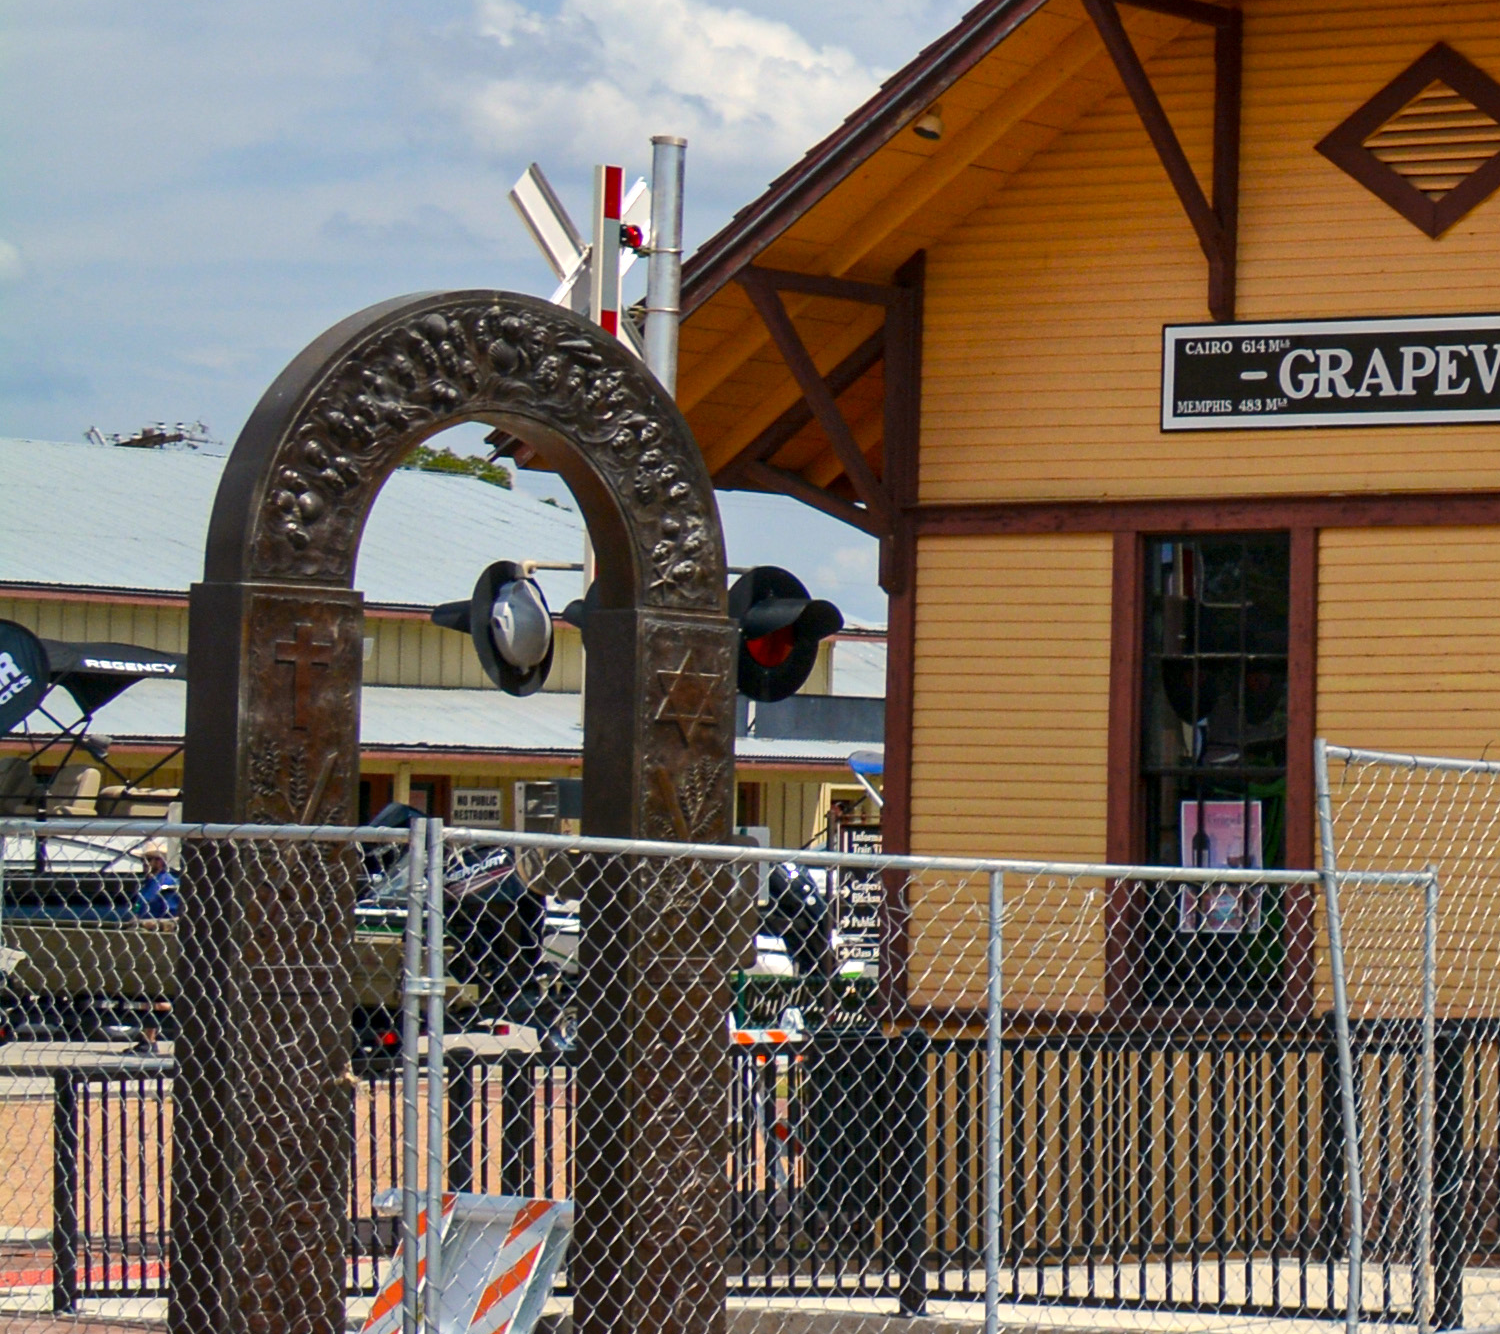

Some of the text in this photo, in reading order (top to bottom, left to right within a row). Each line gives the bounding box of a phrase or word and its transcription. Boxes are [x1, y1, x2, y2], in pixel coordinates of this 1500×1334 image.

[1185, 340, 1233, 355] CAIRO
[1241, 339, 1266, 353] 614
[1176, 399, 1232, 415] MEMPHIS
[1238, 398, 1262, 412] 483
[84, 658, 177, 673] REGENCY
[457, 795, 498, 806] NO PUBLIC
[453, 809, 500, 821] RESTROOMS
